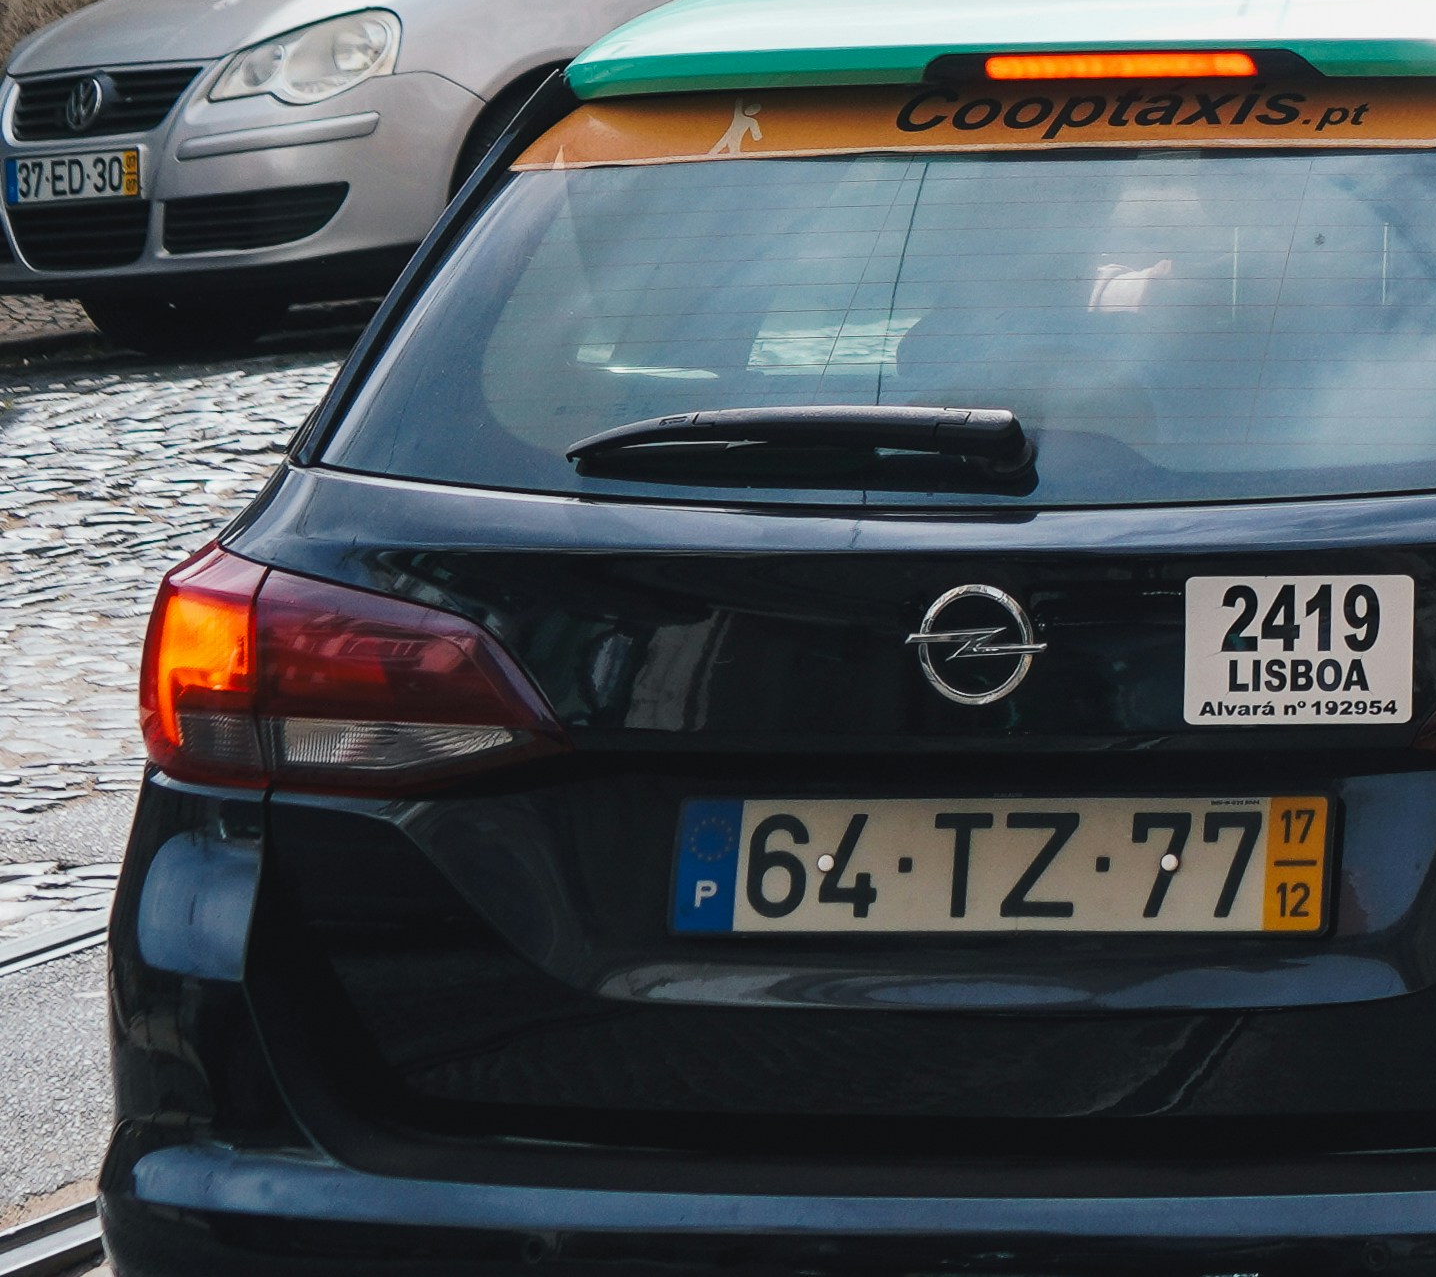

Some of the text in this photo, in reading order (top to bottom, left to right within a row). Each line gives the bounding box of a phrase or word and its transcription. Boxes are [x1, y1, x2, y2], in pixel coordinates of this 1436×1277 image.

[1220, 583, 1381, 653] 2419
[1228, 658, 1370, 693] LISBOA
[1199, 700, 1276, 717] Alvará
[1310, 699, 1399, 716] 192954
[1280, 808, 1316, 844] 17
[694, 879, 719, 909] P
[1276, 881, 1311, 918] 12
